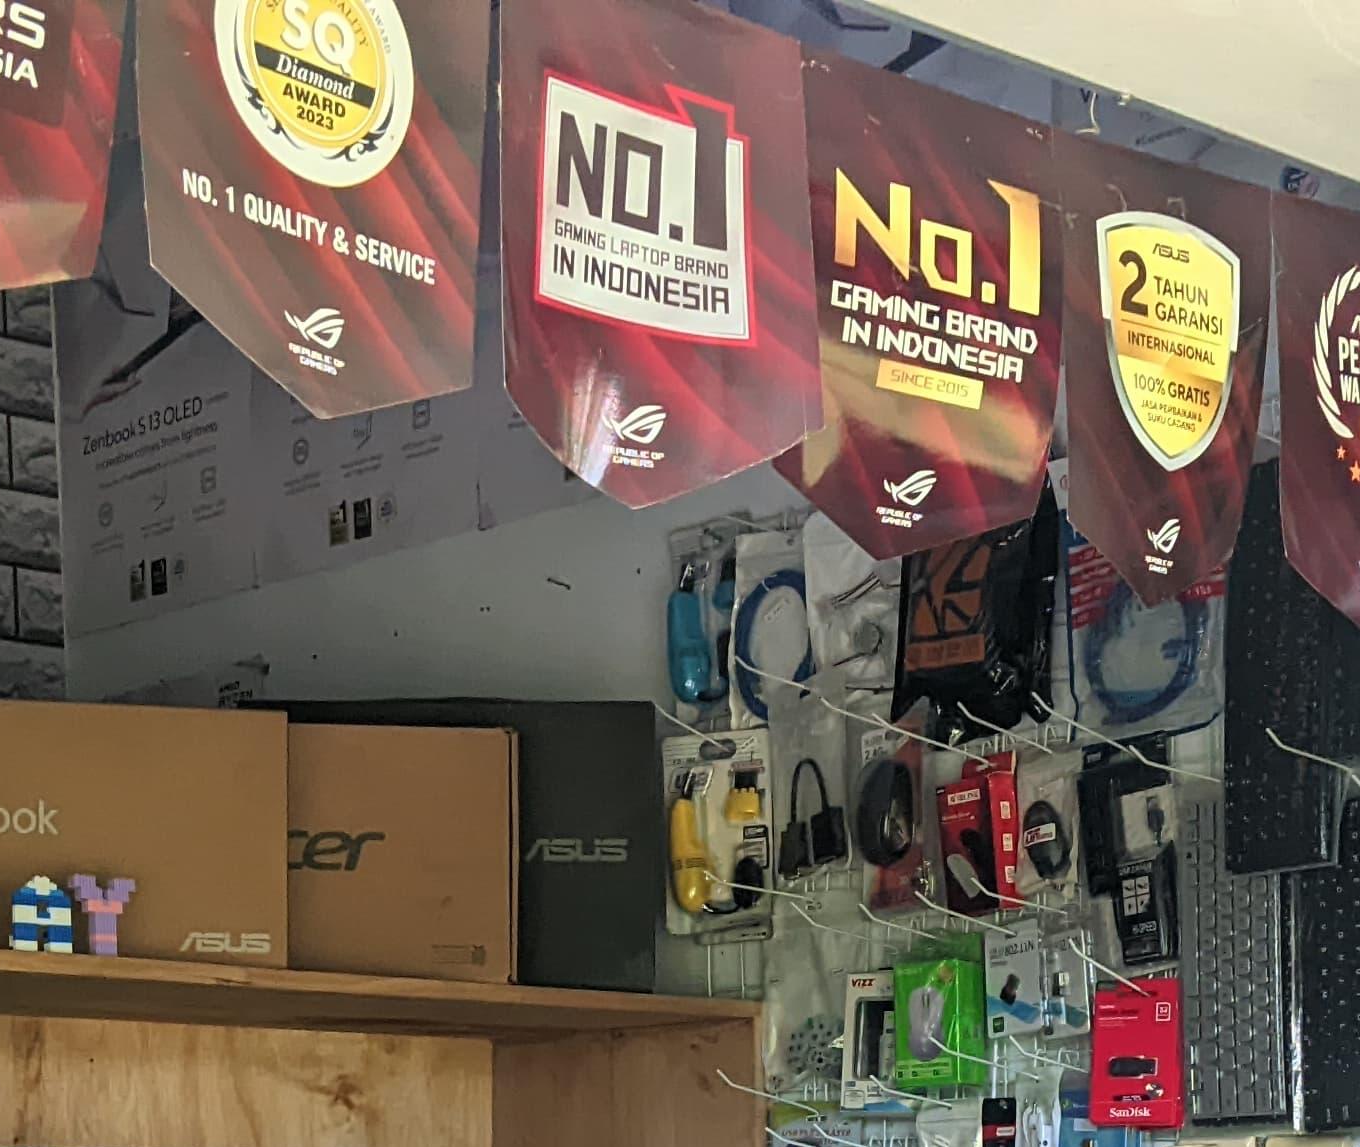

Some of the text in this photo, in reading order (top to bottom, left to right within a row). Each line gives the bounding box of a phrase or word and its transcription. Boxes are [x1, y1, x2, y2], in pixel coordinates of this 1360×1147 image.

[280, 0, 356, 77] SQ
[276, 54, 355, 101] Diamond
[283, 83, 347, 119] AWARD
[296, 105, 334, 131] 2023
[557, 94, 728, 251] NO.1
[182, 168, 436, 285] NO. 1 QUALITY & SERVICE
[554, 219, 729, 280] GAMING LAPTOP BRAND
[1152, 243, 1190, 264] ASUS
[553, 244, 730, 315] IN INDONESIA
[1118, 249, 1149, 318] 2
[1153, 275, 1209, 307] TAHUN
[830, 279, 1038, 355] GAMING BRAND
[1155, 302, 1223, 337] GARANSI
[842, 316, 1024, 383] IN INDONESIA
[1127, 330, 1216, 366] INTERNASIONAL
[890, 368, 969, 399] SINCE 2015
[1134, 372, 1210, 408] 100% GRATIS
[82, 396, 203, 456] Zenbook S 13 OLED
[288, 829, 386, 872] cer
[525, 837, 629, 863] ASUS
[180, 931, 272, 955] ASUS
[1109, 1106, 1153, 1119] SanDisk
